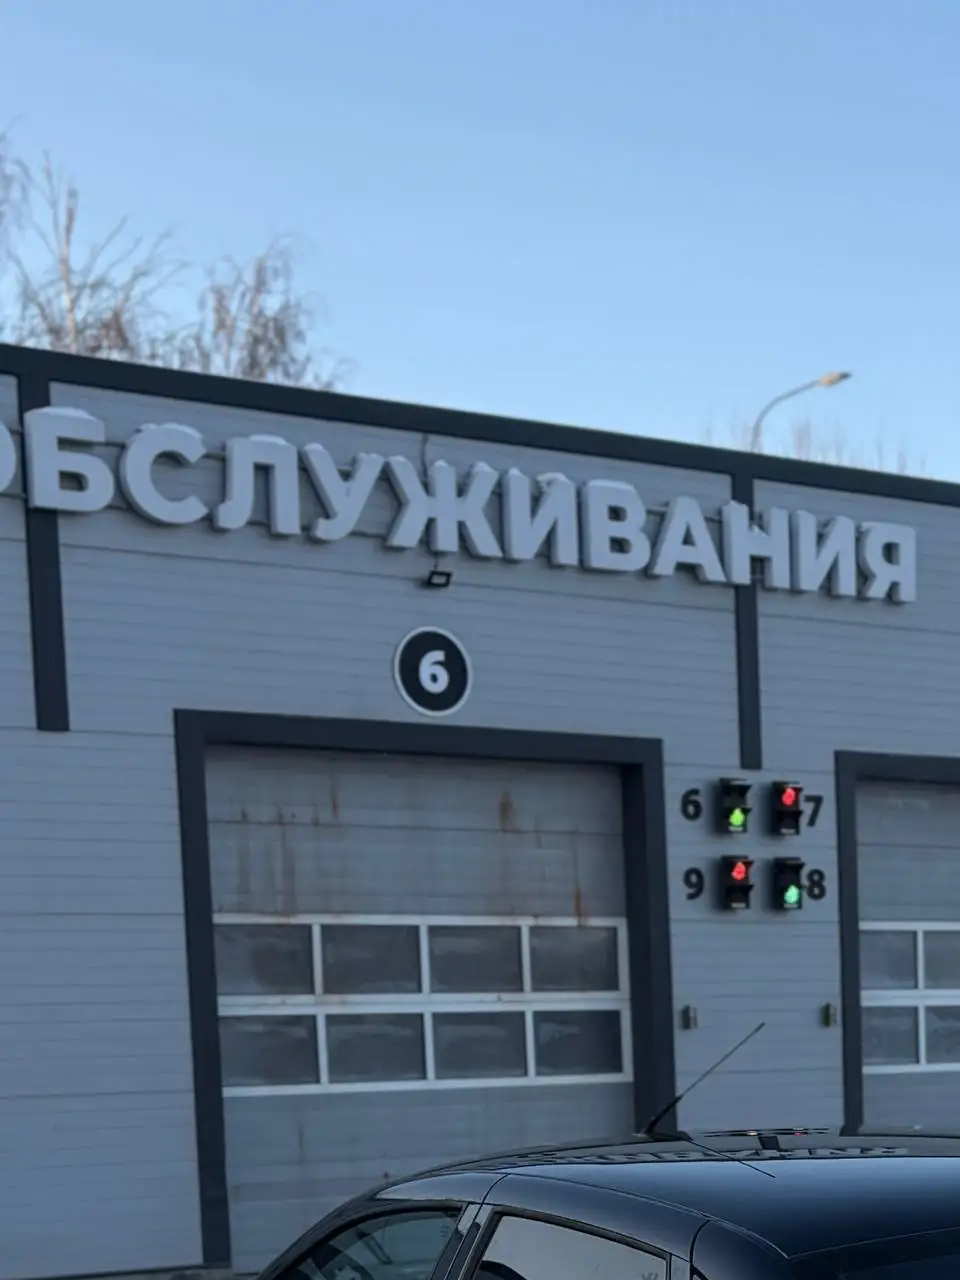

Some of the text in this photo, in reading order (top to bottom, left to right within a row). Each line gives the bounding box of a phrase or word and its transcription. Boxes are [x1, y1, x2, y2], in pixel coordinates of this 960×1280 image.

[0, 405, 916, 603] БСЛУЖИВАНИЯ
[418, 649, 449, 694] 6
[680, 788, 702, 821] 6
[803, 794, 824, 828] 7
[682, 867, 704, 901] 9
[806, 868, 826, 900] 8
